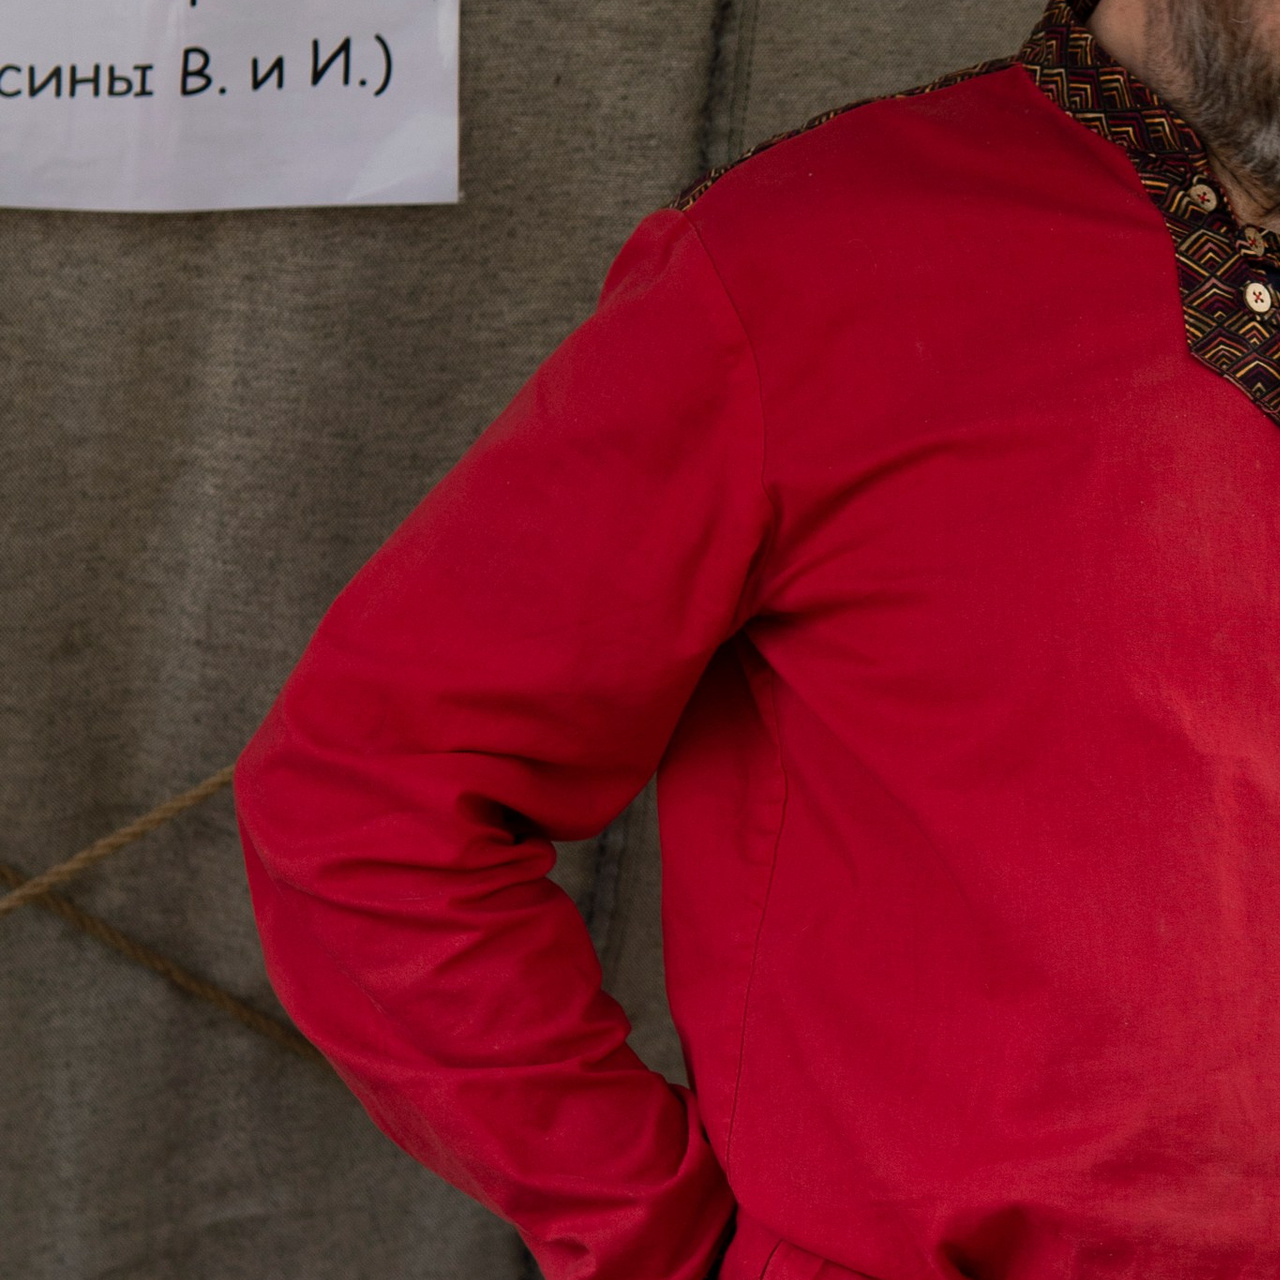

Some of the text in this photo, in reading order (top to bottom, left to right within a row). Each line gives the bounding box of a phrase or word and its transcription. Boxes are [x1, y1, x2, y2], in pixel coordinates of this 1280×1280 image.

[0, 33, 393, 99] сины В. и И.)
